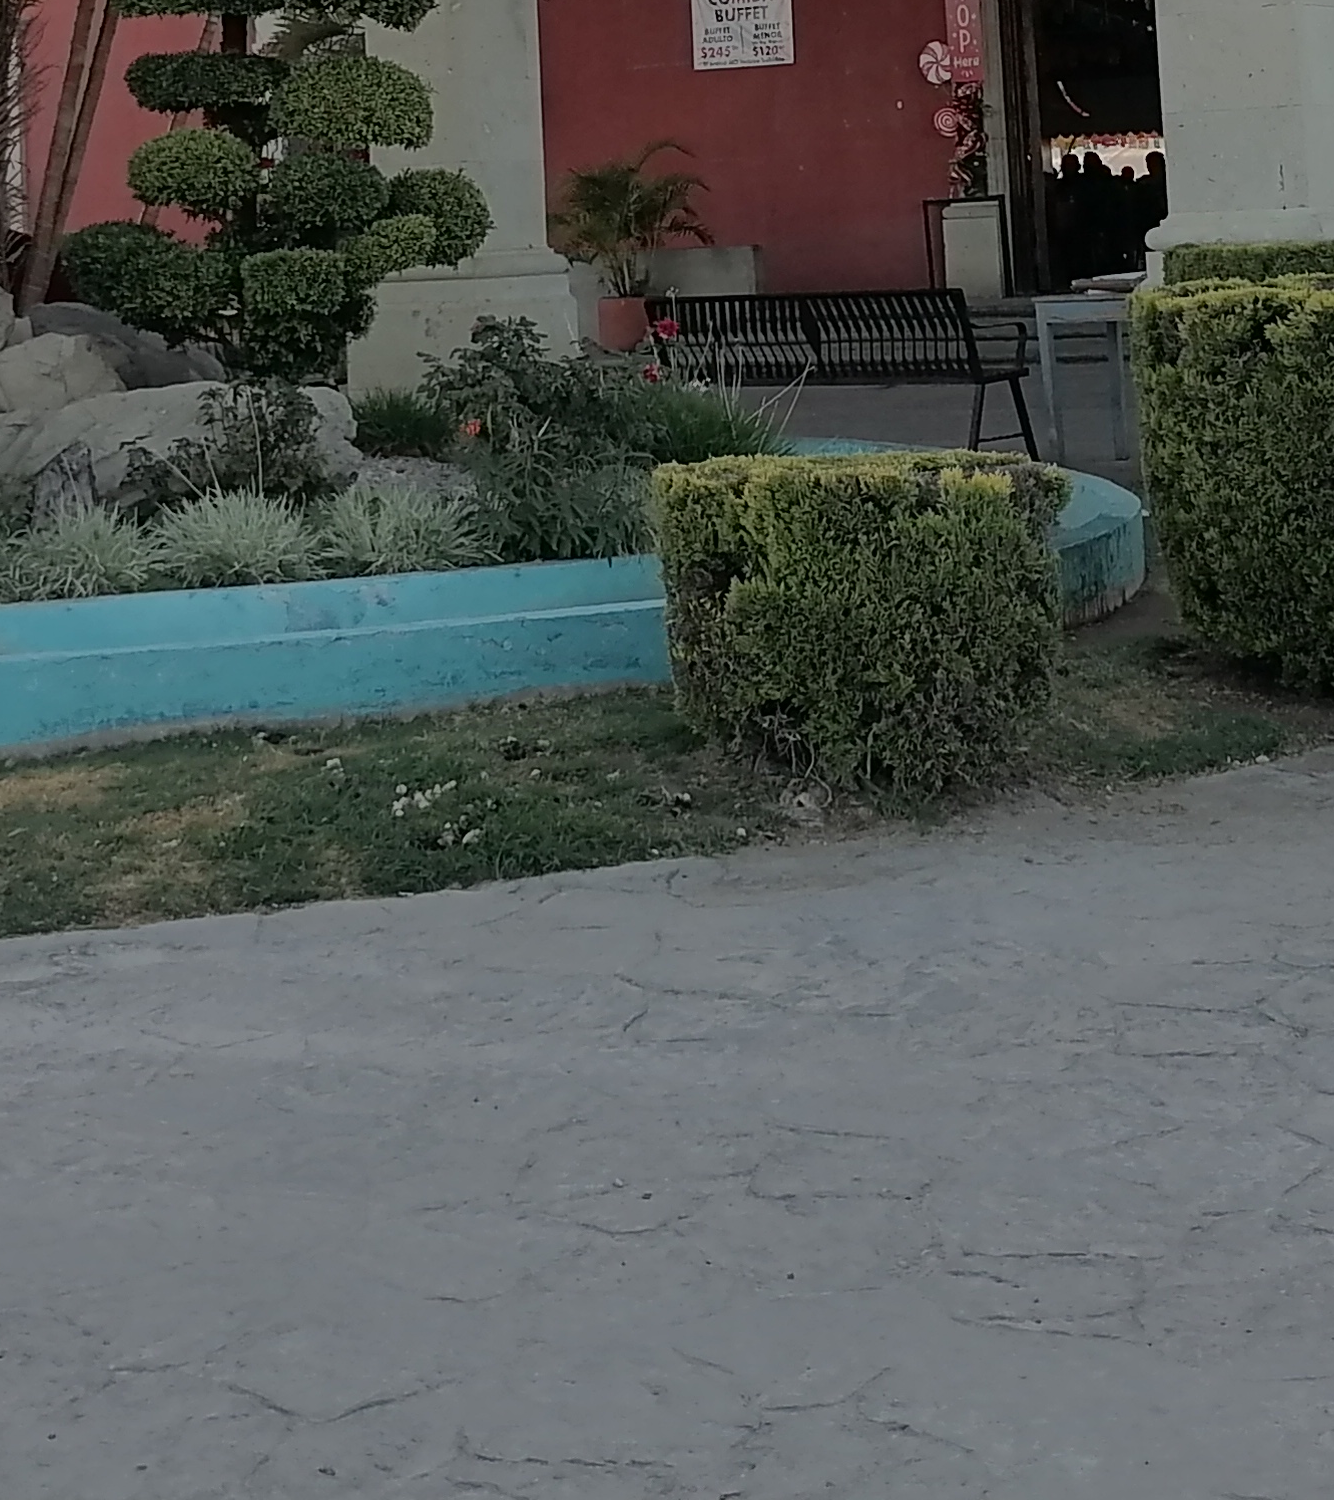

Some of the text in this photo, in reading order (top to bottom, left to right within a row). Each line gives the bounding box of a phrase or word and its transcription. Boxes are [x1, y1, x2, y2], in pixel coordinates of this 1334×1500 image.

[714, 5, 769, 22] BUFFET
[704, 26, 730, 36] BUFFET
[754, 22, 780, 31] BUFFET
[953, 56, 980, 68] Here
